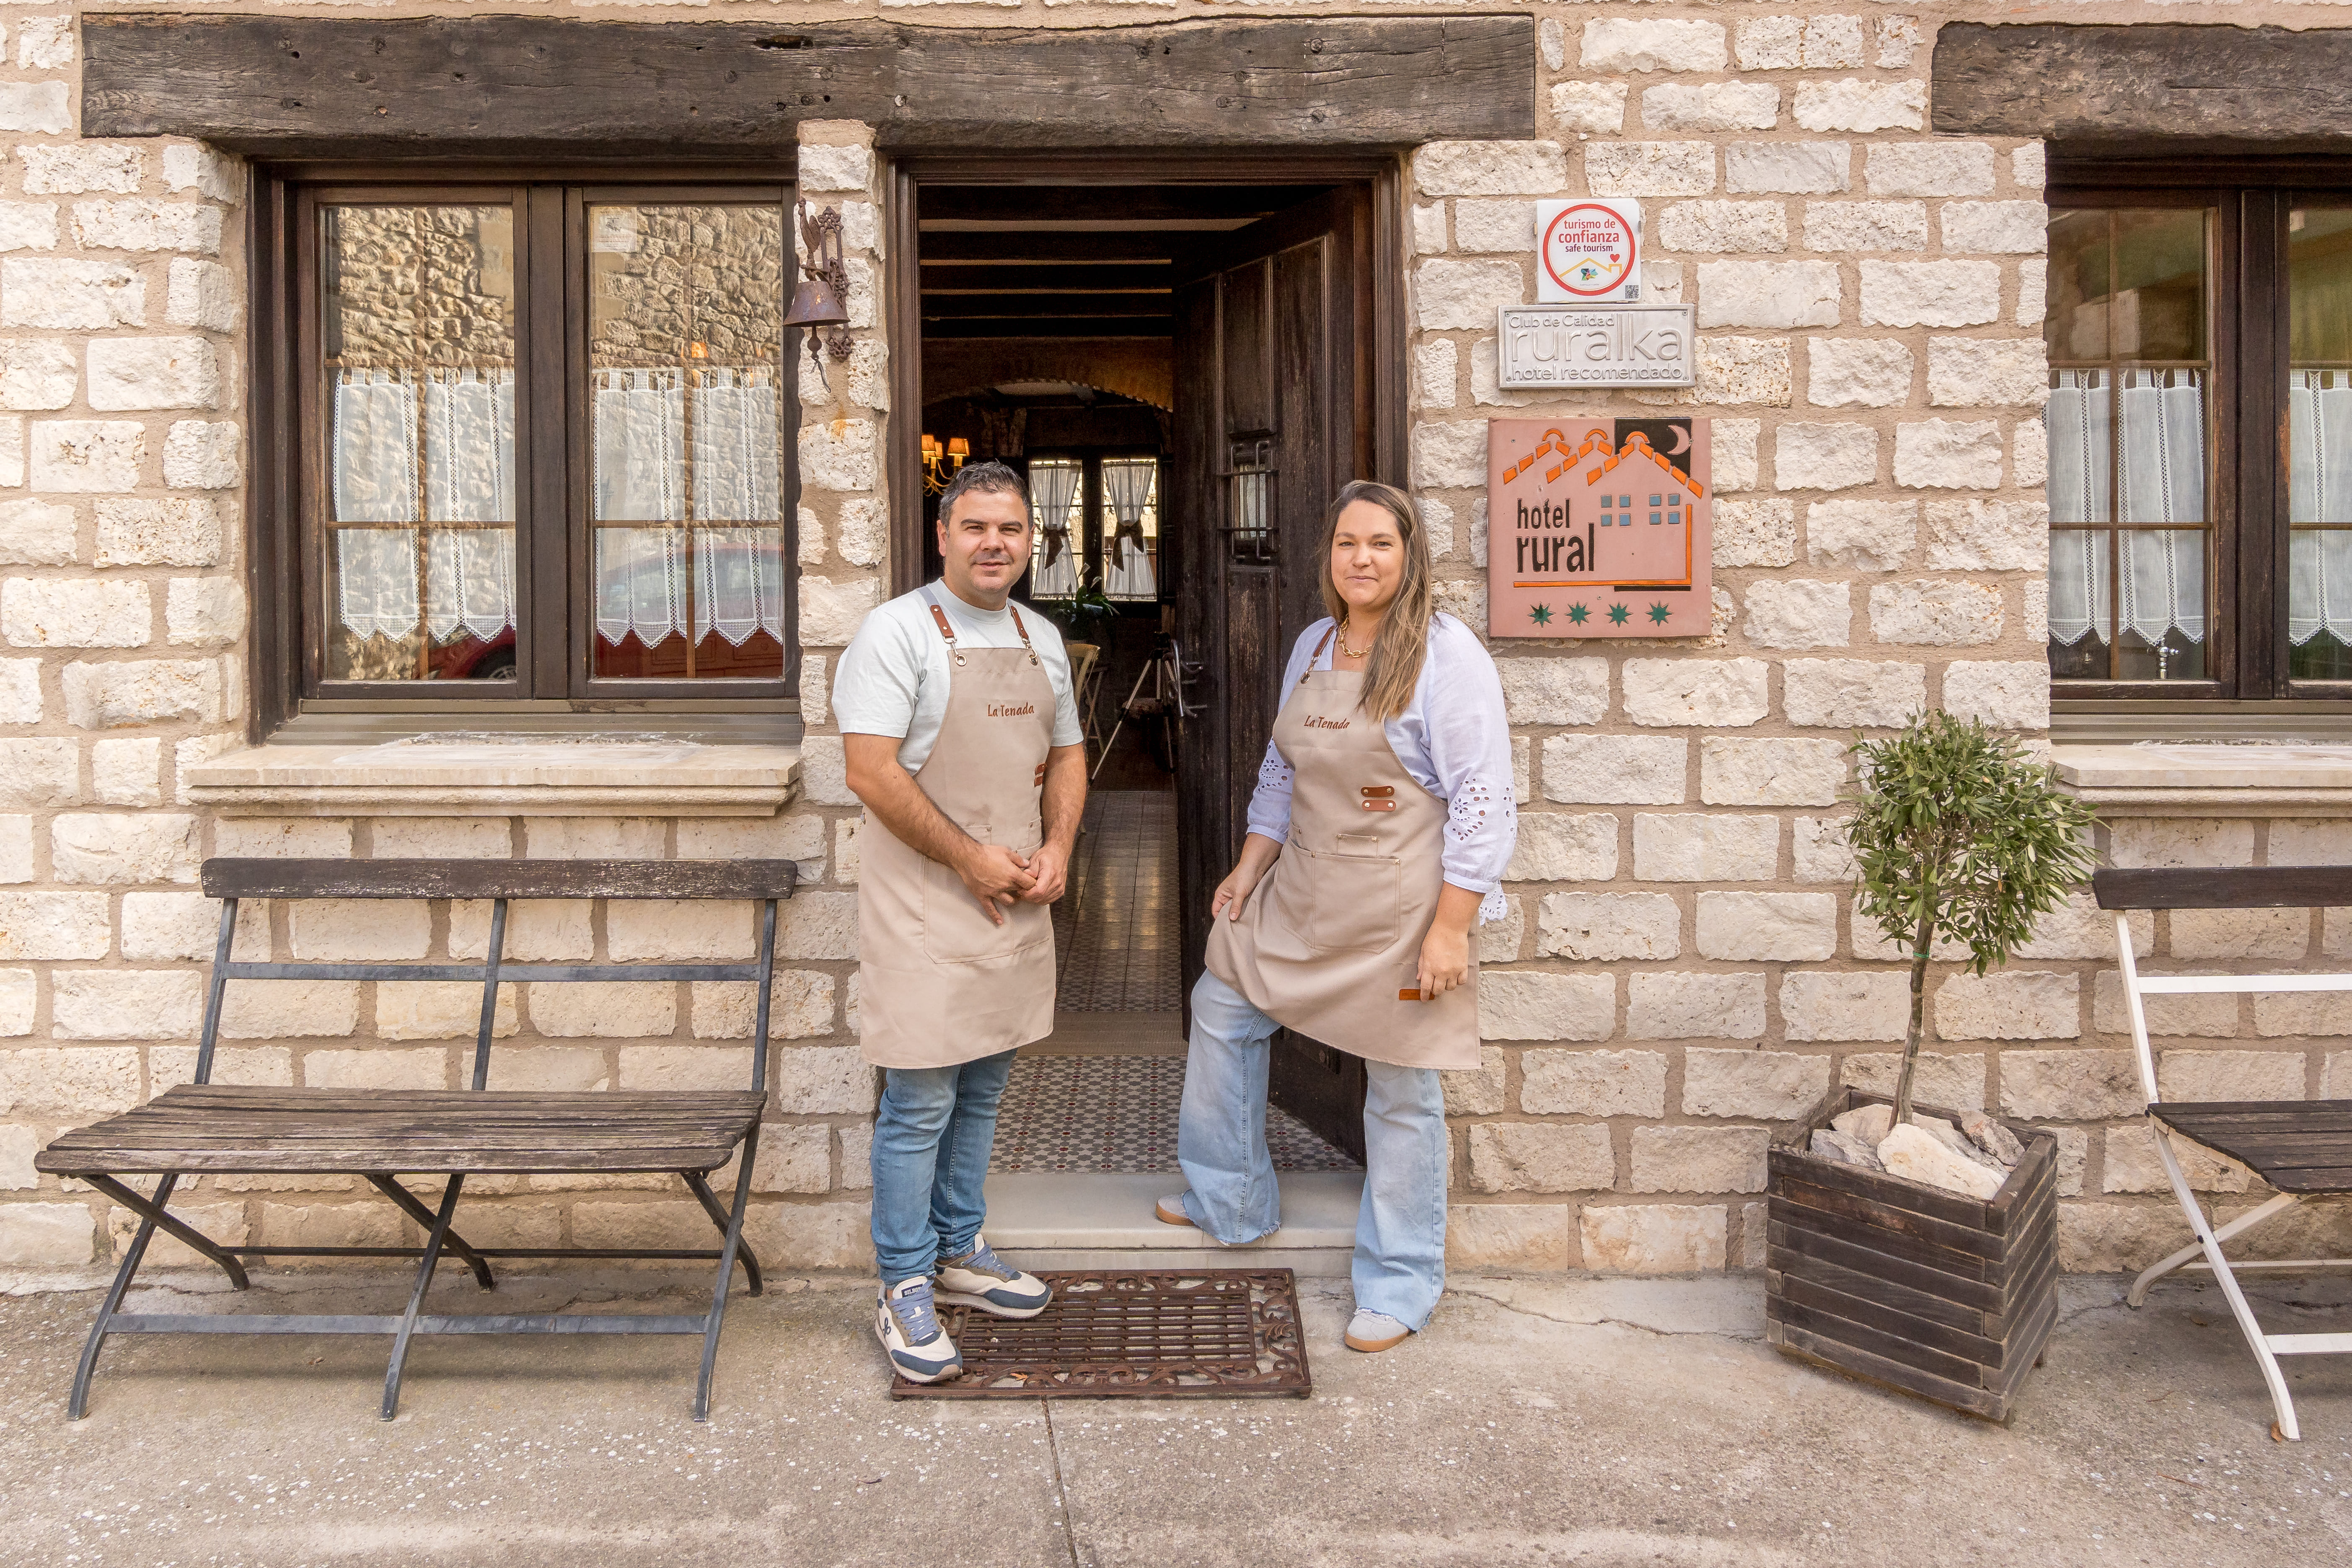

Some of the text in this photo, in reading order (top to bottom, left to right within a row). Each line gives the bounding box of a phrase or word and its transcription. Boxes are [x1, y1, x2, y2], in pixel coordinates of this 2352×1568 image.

[1564, 218, 1615, 229] turismo de
[1558, 230, 1619, 243] confianza
[1509, 313, 1614, 328] Club de Calidad
[1511, 313, 1682, 362] ruralka
[1512, 362, 1682, 380] hotel recomendado
[1517, 497, 1571, 529] hotel
[1516, 522, 1594, 573] rural
[988, 701, 1035, 717] La Tenada
[1304, 715, 1350, 729] La Tenada
